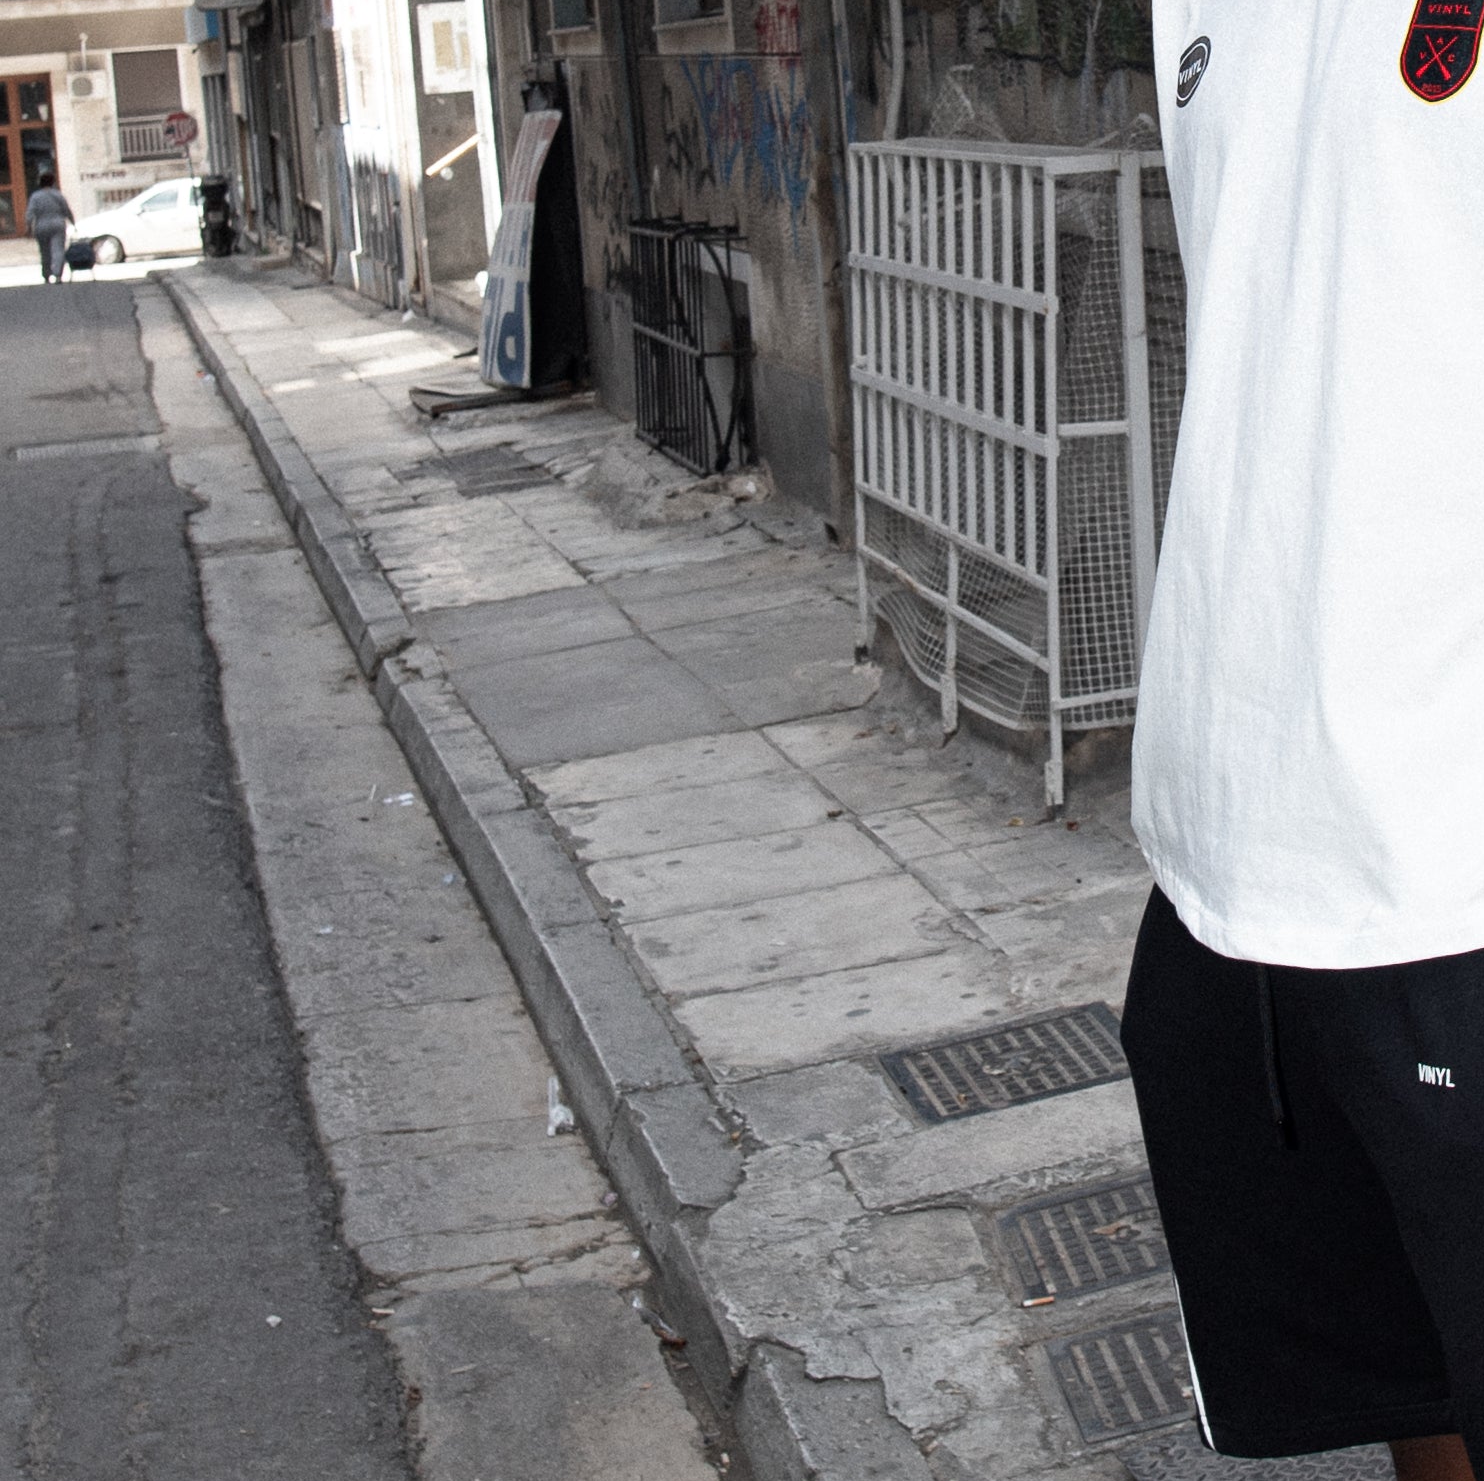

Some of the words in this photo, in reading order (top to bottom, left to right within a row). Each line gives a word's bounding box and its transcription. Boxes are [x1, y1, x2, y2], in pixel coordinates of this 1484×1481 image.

[1427, 4, 1472, 15] VINYL
[1179, 58, 1202, 86] VINYL
[1417, 1062, 1456, 1089] VINYL
